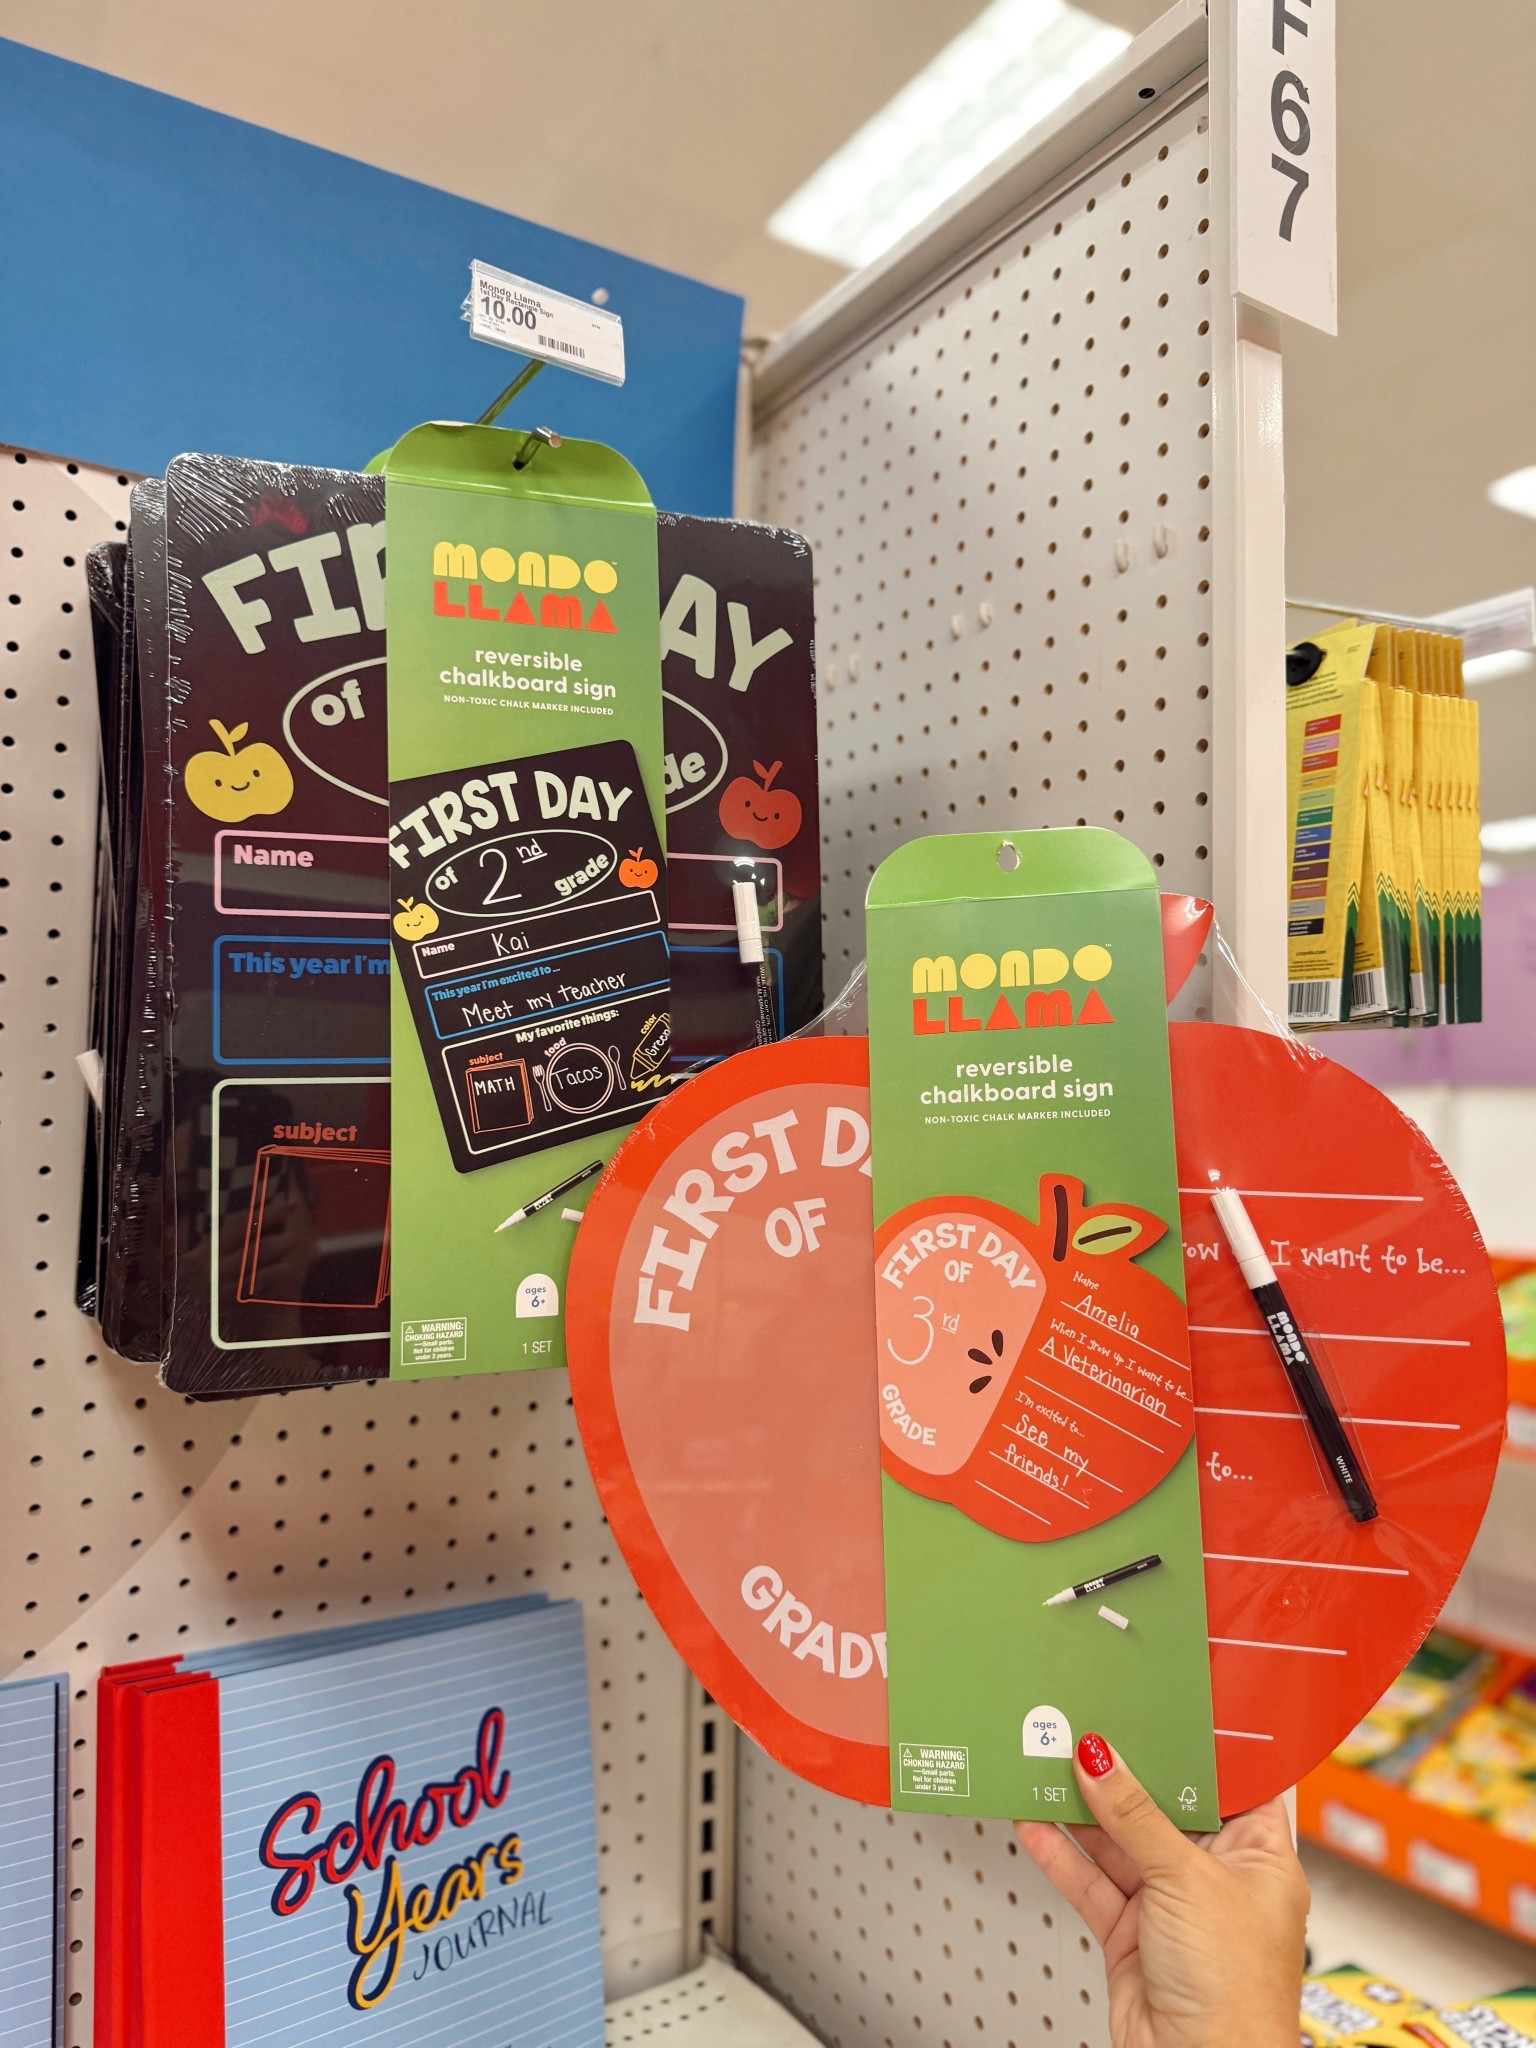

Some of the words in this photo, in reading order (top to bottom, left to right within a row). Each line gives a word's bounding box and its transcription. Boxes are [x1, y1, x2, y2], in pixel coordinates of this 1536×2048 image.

[480, 279, 511, 298] Mondo
[514, 291, 541, 308] Llama
[480, 287, 490, 296] 1st
[491, 291, 505, 303] Day
[506, 297, 538, 313] Rectangle
[540, 308, 554, 319] Sign
[481, 296, 537, 330] 10.00
[433, 541, 618, 594] MONDO
[433, 580, 620, 635] LLAMA
[475, 649, 583, 672] reversible
[439, 666, 568, 694] chalkboard
[573, 677, 616, 701] sign
[311, 678, 365, 726] of
[444, 694, 497, 706] NON-TOXIC
[500, 699, 530, 709] CHALK
[532, 702, 568, 712] MARKER
[571, 705, 614, 716] INCLUDED
[534, 770, 633, 822] DAY
[233, 844, 314, 869] Name
[434, 866, 459, 891] of
[554, 854, 610, 896] grade
[421, 940, 455, 957] Name
[490, 931, 531, 957] Kai
[229, 951, 286, 974] This
[289, 956, 350, 979] year
[354, 955, 390, 975] I'm
[912, 944, 1112, 994] MONDO
[432, 988, 459, 1001] This
[456, 983, 481, 998] year
[481, 979, 499, 990] I'm
[499, 967, 539, 985] excited
[462, 1001, 514, 1027] Meet
[527, 992, 553, 1012] my
[557, 971, 627, 1002] teacher
[913, 987, 1115, 1035] LLAMA
[515, 1032, 535, 1043] My
[534, 1019, 582, 1038] favorite
[581, 1009, 620, 1026] things:
[640, 1013, 658, 1035] color
[468, 1052, 504, 1066] subject
[956, 1054, 1073, 1078] reversible
[474, 1076, 516, 1096] MATH
[550, 1066, 603, 1090] Tacos
[920, 1079, 1056, 1105] chalkboard
[1063, 1078, 1114, 1102] sign
[924, 1114, 980, 1125] NON-TOXIC
[982, 1112, 1015, 1122] CHALK
[1017, 1110, 1058, 1121] MARKER
[1060, 1108, 1111, 1119] INCLUDED
[273, 1122, 358, 1144] subject
[633, 1109, 799, 1332] FIRST
[821, 1106, 873, 1178] D
[764, 1197, 827, 1258] OF
[881, 1222, 976, 1290] FIRST
[977, 1231, 1037, 1291] DAY
[1182, 1242, 1219, 1261] ow
[1270, 1239, 1290, 1266] I
[1301, 1243, 1372, 1274] want
[1381, 1245, 1408, 1274] to
[1417, 1247, 1466, 1275] be...
[944, 1259, 974, 1284] OF
[1072, 1271, 1100, 1290] Name
[525, 1286, 546, 1296] ages
[531, 1295, 546, 1308] 6+
[422, 1321, 464, 1333] WARNING:
[1074, 1294, 1139, 1339] Amelia
[405, 1333, 435, 1342] CHOKING
[436, 1330, 463, 1340] HAZARD
[438, 1339, 454, 1347] parts.
[522, 1342, 528, 1355] 1
[532, 1340, 553, 1354] SET
[1266, 1314, 1295, 1366] LLAMA
[1276, 1311, 1306, 1362] MONDO
[436, 1353, 453, 1361] years.
[1050, 1318, 1076, 1339] When
[1077, 1333, 1087, 1345] I
[1087, 1339, 1111, 1357] grow
[1113, 1352, 1124, 1366] up
[1125, 1358, 1136, 1371] I
[1137, 1366, 1163, 1387] want
[1165, 1379, 1174, 1392] to
[1175, 1386, 1193, 1402] be...
[1041, 1336, 1055, 1357] A
[1064, 1344, 1167, 1417] Veterinarian
[881, 1383, 937, 1447] GRADE
[1015, 1390, 1035, 1408] I'm
[1035, 1404, 1069, 1428] excited
[1069, 1421, 1085, 1437] to...
[1016, 1414, 1048, 1447] See
[1063, 1446, 1089, 1477] my
[1005, 1443, 1069, 1490] friends!
[1206, 1451, 1253, 1481] to...
[1335, 1455, 1353, 1485] WHITE
[1033, 1719, 1057, 1730] ages
[1040, 1732, 1057, 1746] 6+
[903, 1758, 935, 1768] CHOKING
[935, 1761, 965, 1770] HAZARD
[920, 1748, 965, 1761] WARNING:
[912, 1775, 923, 1783] Not
[933, 1777, 956, 1785] children
[915, 1783, 932, 1791] under
[937, 1784, 955, 1792] years.
[1033, 1787, 1038, 1801] 1
[1044, 1787, 1068, 1802] SET
[259, 1706, 511, 1916] School
[1182, 1804, 1198, 1812] FSC
[343, 1832, 524, 2010] Years
[413, 1891, 552, 1981] JOURNAL
